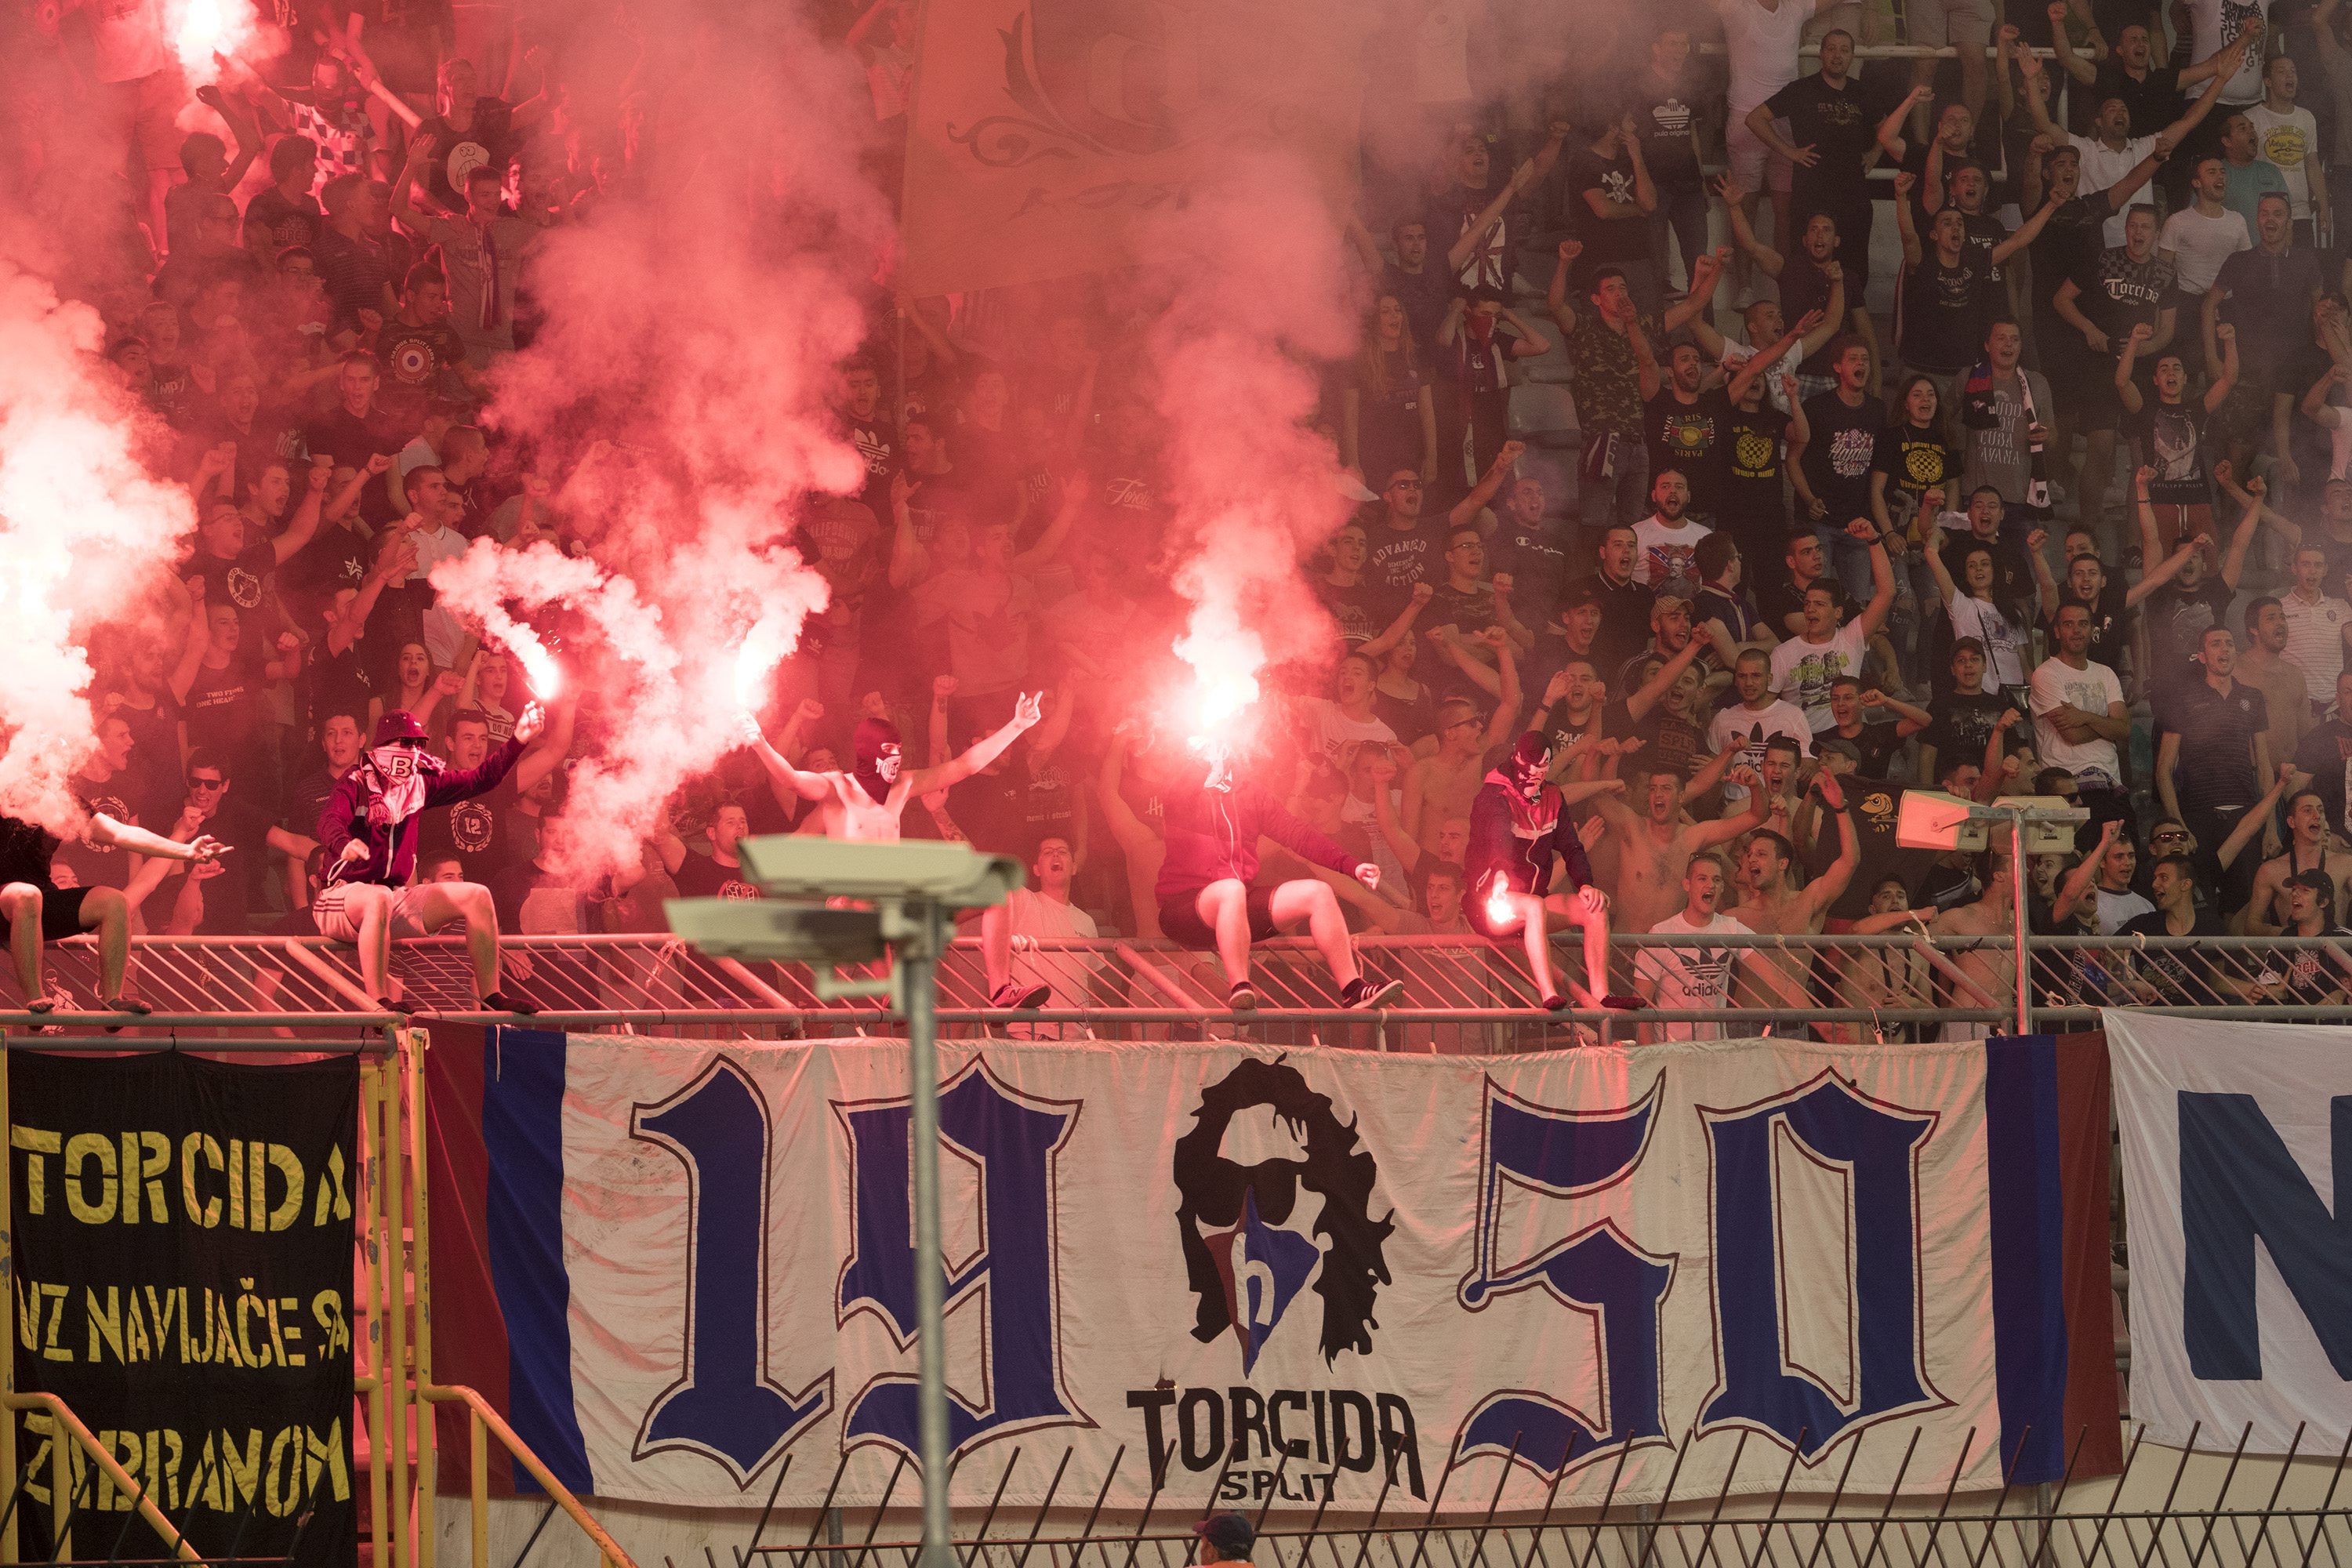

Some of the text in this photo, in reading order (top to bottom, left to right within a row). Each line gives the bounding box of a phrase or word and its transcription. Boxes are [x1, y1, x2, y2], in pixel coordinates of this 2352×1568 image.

[408, 338, 426, 348] SPLIT
[1661, 414, 1675, 443] PARIS
[1385, 562, 1425, 587] ACTION
[197, 699, 212, 709] ONE
[206, 691, 223, 699] TWO
[390, 755, 413, 778] B
[1734, 759, 1763, 773] adid
[464, 817, 482, 835] 12
[10, 1123, 351, 1232] TORCIDA
[86, 1277, 306, 1369] NAVIJAČE
[1127, 1386, 1427, 1502] TORCIDA
[1220, 1470, 1338, 1502] SPLIT
